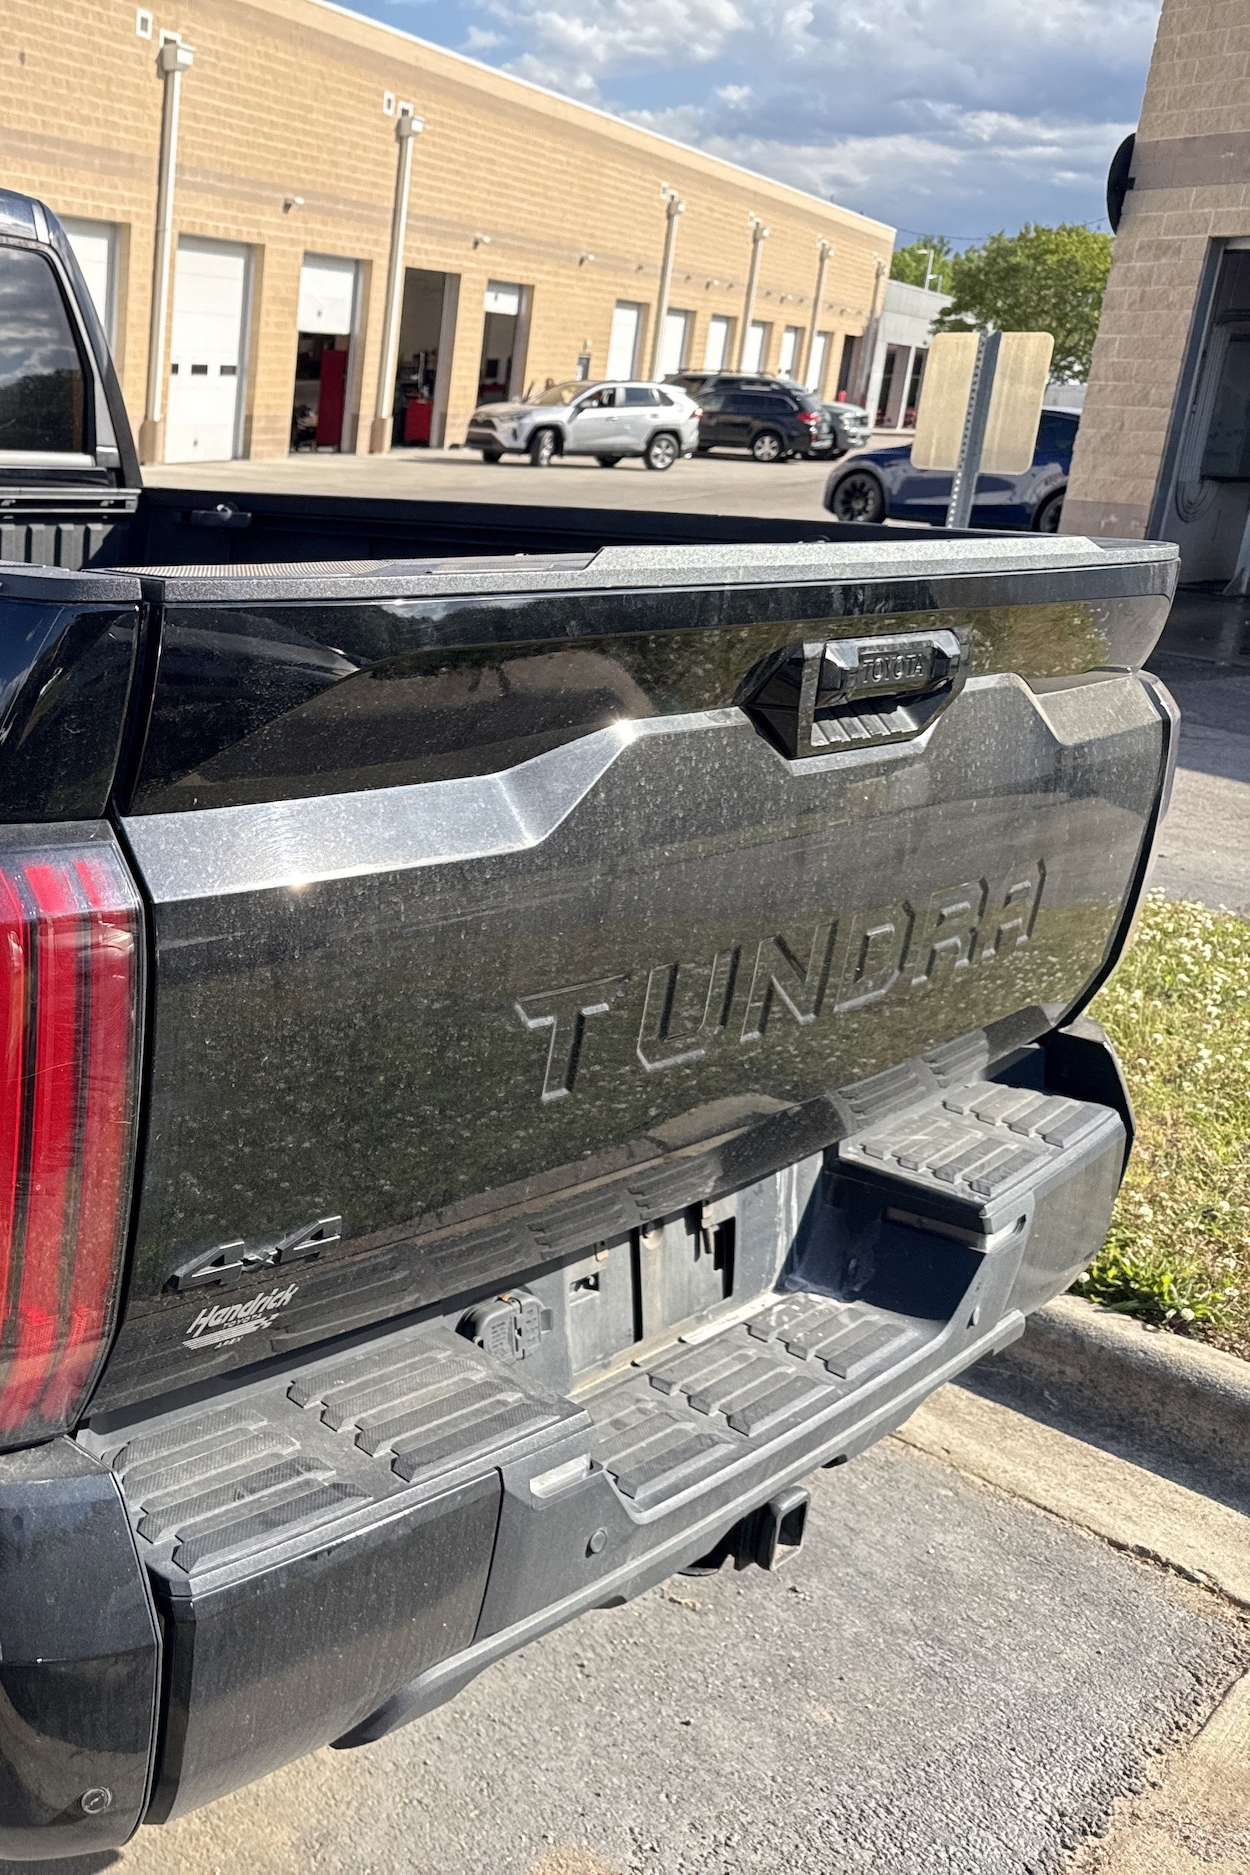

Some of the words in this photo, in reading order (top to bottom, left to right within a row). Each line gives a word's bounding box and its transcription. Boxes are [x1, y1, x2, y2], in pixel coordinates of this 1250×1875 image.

[862, 653, 924, 684] TOYOTA
[514, 858, 1047, 1101] TUNDRA
[185, 1283, 300, 1339] Hendrick
